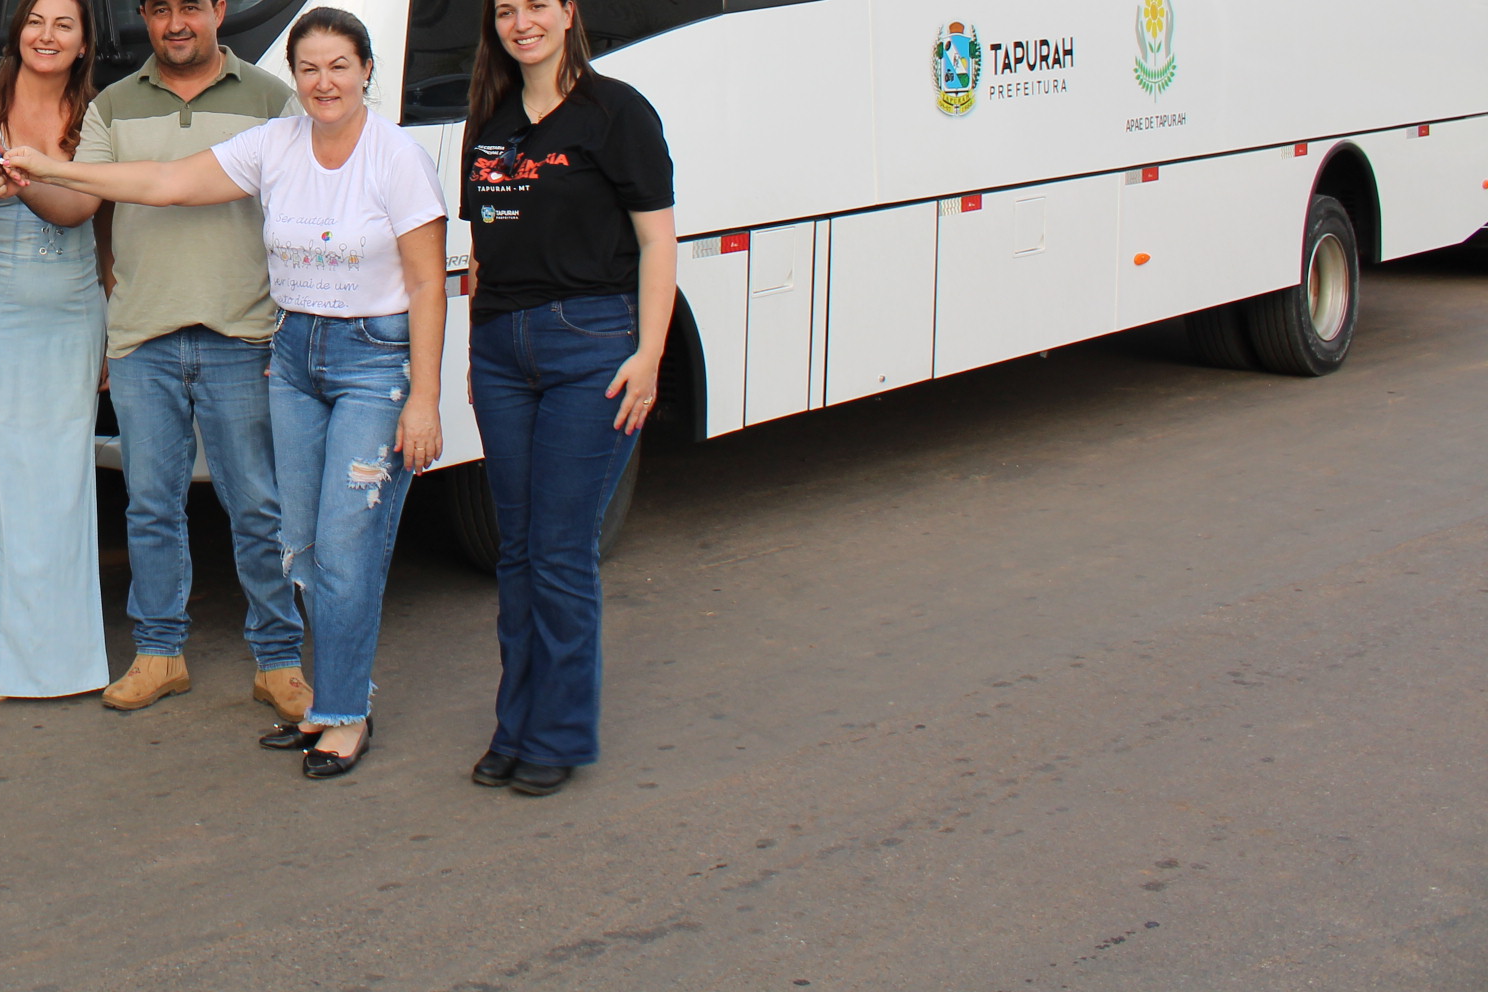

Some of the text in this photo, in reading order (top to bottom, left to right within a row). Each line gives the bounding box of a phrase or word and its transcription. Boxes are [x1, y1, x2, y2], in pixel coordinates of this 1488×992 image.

[989, 37, 1074, 75] TAPURAH
[989, 79, 1067, 100] PREFEITURA
[1125, 112, 1186, 133] APAE DE TAPURAH
[316, 279, 331, 290] de
[334, 283, 359, 292] um
